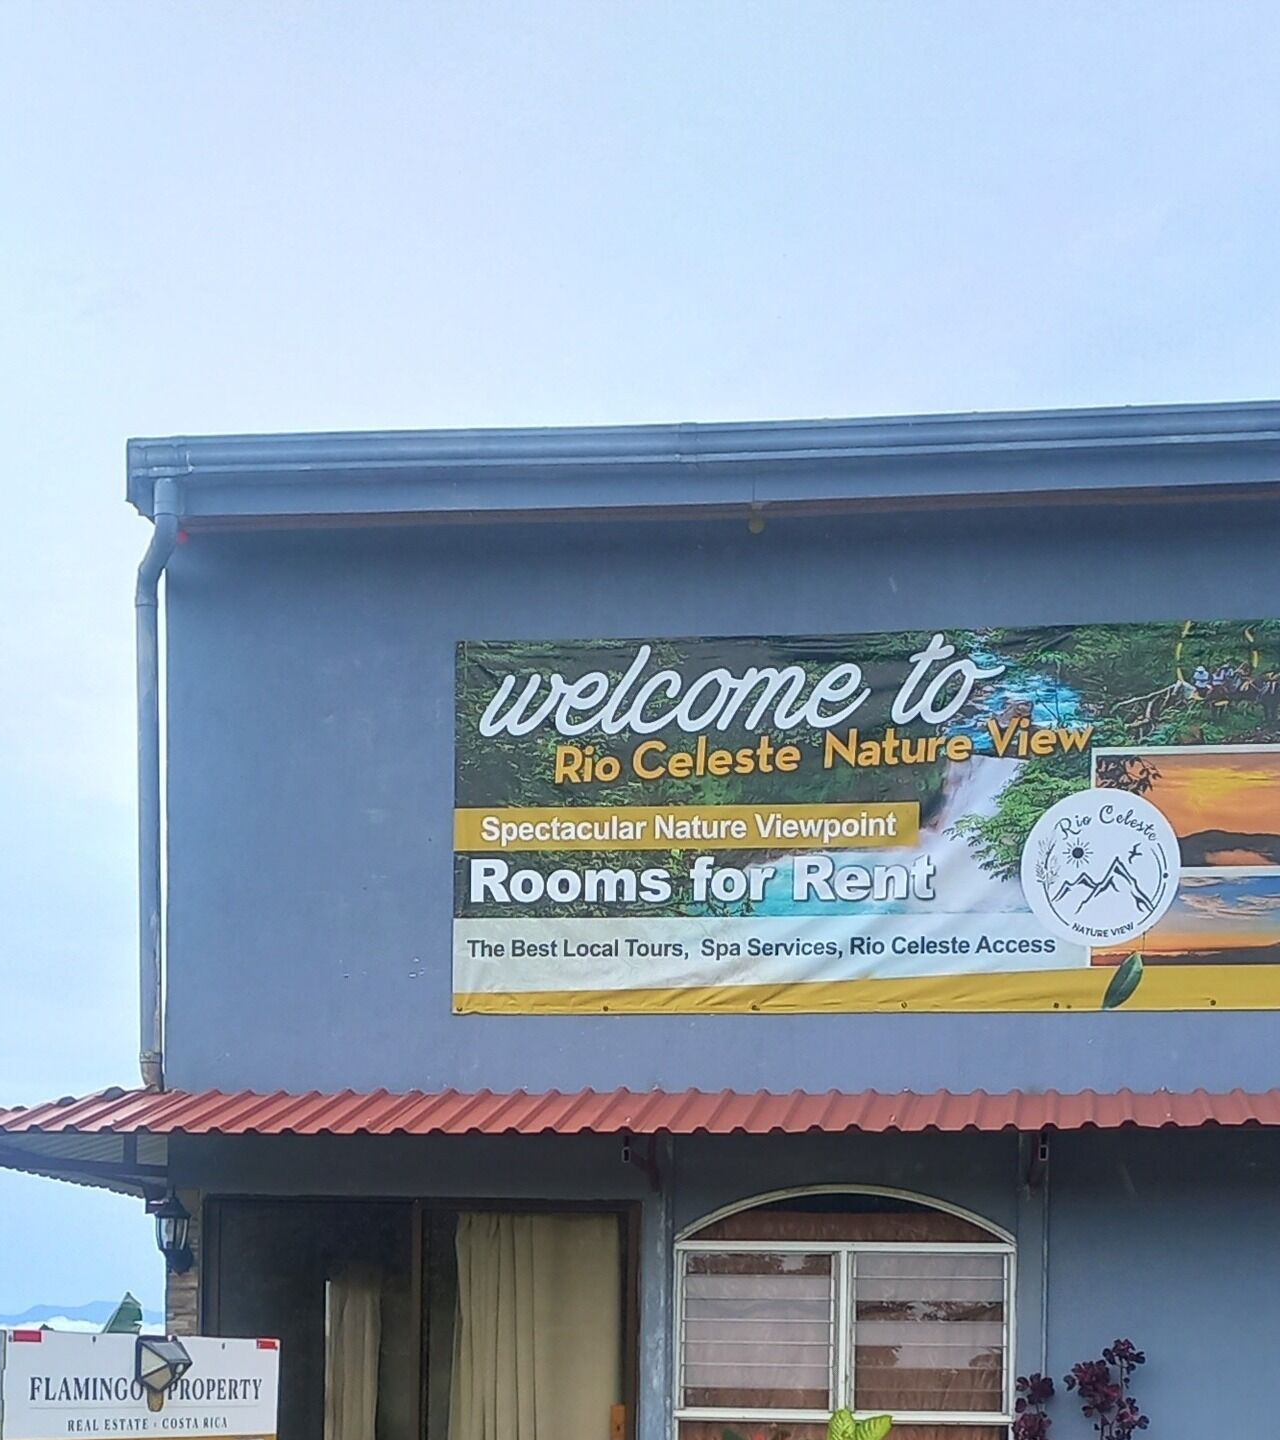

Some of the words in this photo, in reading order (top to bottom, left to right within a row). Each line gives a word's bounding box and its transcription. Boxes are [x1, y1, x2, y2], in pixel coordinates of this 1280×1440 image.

[479, 645, 871, 737] welcome
[891, 633, 1005, 725] to
[555, 745, 620, 784] Rio
[632, 736, 801, 780] Celeste
[824, 728, 972, 768] Nature
[988, 718, 1094, 757] View
[481, 815, 647, 846] Spectacular
[654, 814, 747, 840] Nature
[754, 811, 896, 843] Viewpoint
[1054, 814, 1092, 842] Rio
[1099, 805, 1158, 842] Celeste
[470, 858, 671, 903] Rooms
[690, 856, 777, 902] for
[793, 854, 935, 901] Rent
[1072, 922, 1108, 937] NATURE
[1110, 921, 1134, 936] VIEW
[467, 939, 505, 958] The
[511, 939, 560, 958] Best
[563, 939, 619, 957] Local
[624, 939, 689, 960] Tours,
[701, 939, 740, 960] Spa
[747, 937, 842, 959] Services,
[850, 936, 885, 955] Rio
[891, 935, 970, 955] Celeste
[976, 935, 1055, 954] Access
[30, 1377, 144, 1401] FLAMINGO
[168, 1377, 263, 1401] PROPERTY
[68, 1419, 98, 1432] REAL
[105, 1417, 148, 1430] ESTATE
[162, 1417, 198, 1429] COSTA
[203, 1417, 228, 1428] RICA
